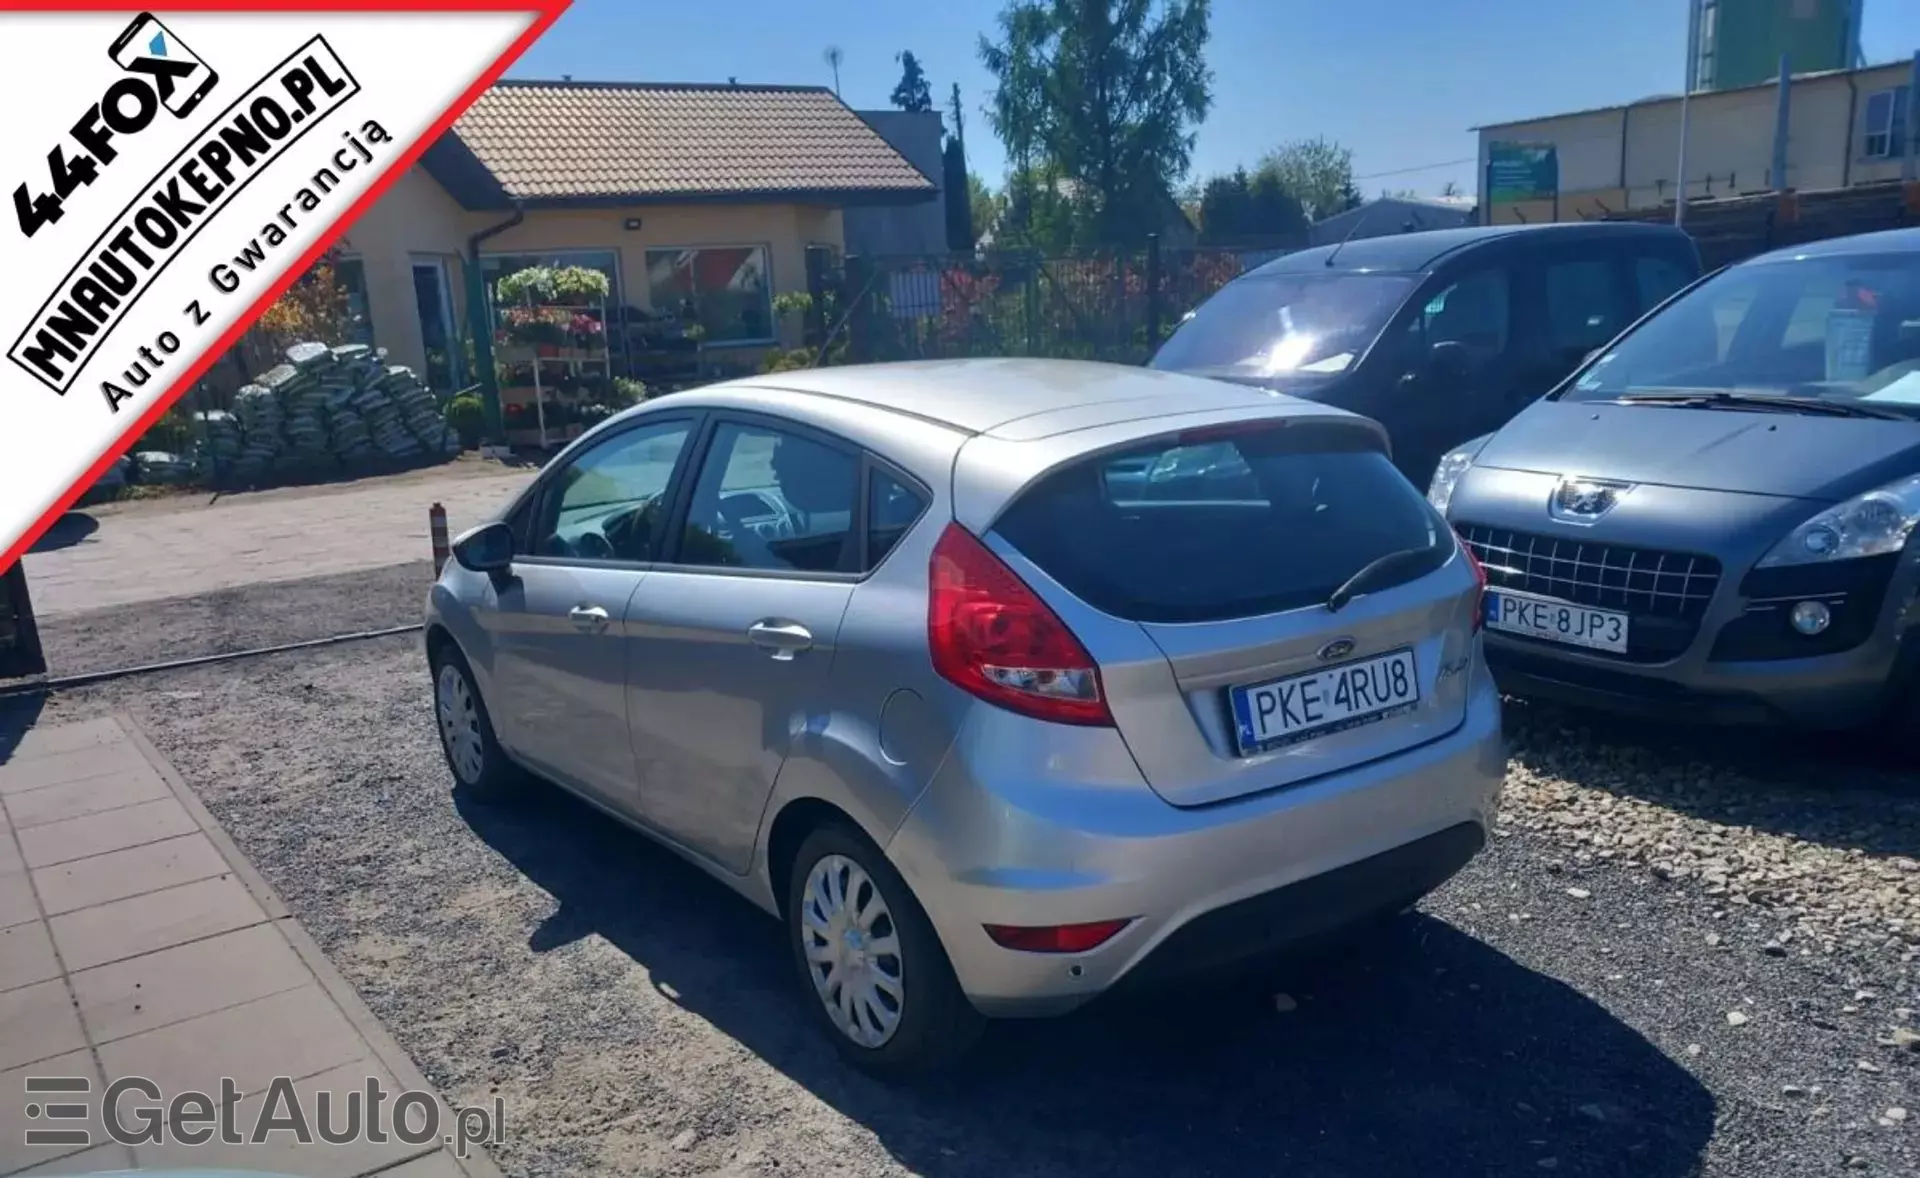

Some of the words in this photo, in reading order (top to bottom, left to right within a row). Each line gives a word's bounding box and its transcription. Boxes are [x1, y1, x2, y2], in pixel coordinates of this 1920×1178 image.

[1503, 597, 1549, 630] PKE
[1557, 608, 1622, 642] 8JP3
[1256, 679, 1323, 735] PKE
[1334, 660, 1409, 712] 4RU8
